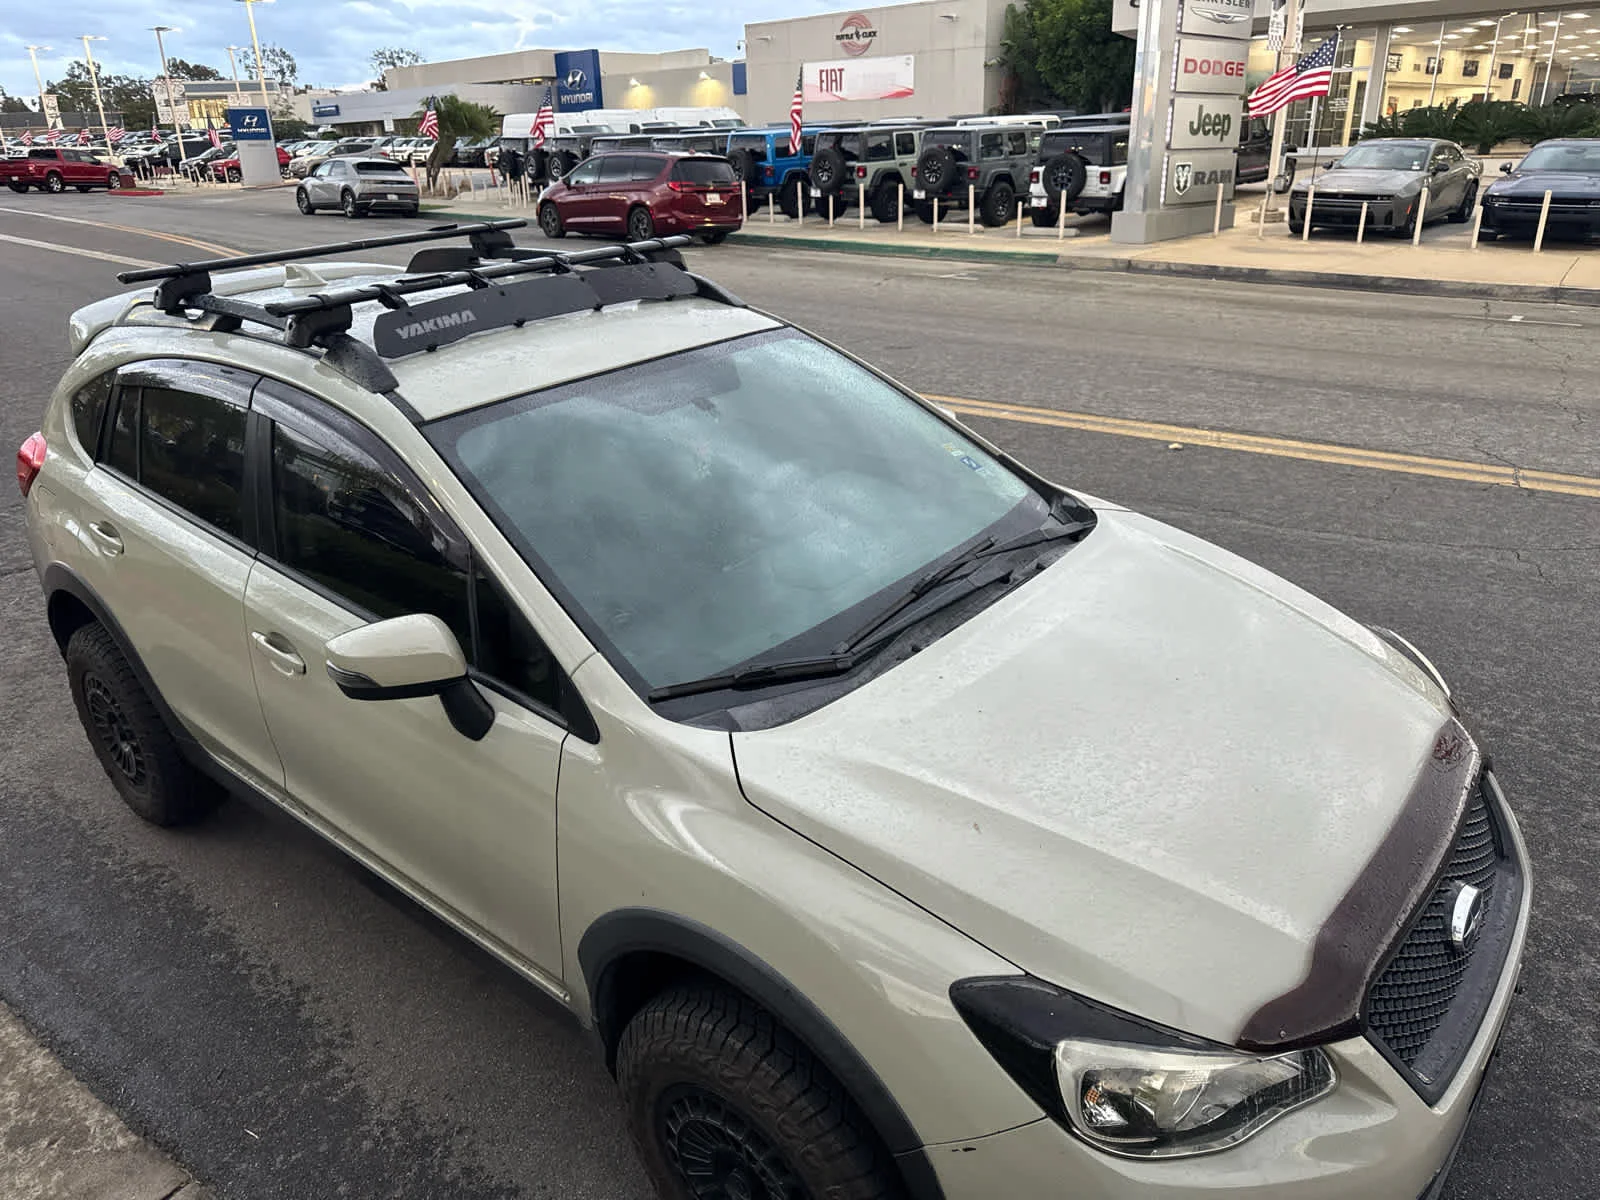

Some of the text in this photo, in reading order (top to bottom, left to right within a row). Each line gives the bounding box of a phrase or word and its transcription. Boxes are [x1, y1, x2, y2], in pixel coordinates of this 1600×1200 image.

[1183, 57, 1245, 77] DODGE
[819, 67, 845, 93] FIAT
[560, 92, 593, 105] HYUNDAI
[1189, 104, 1231, 142] Jeep
[1193, 169, 1233, 185] RAM
[394, 309, 477, 339] YAKIMA
